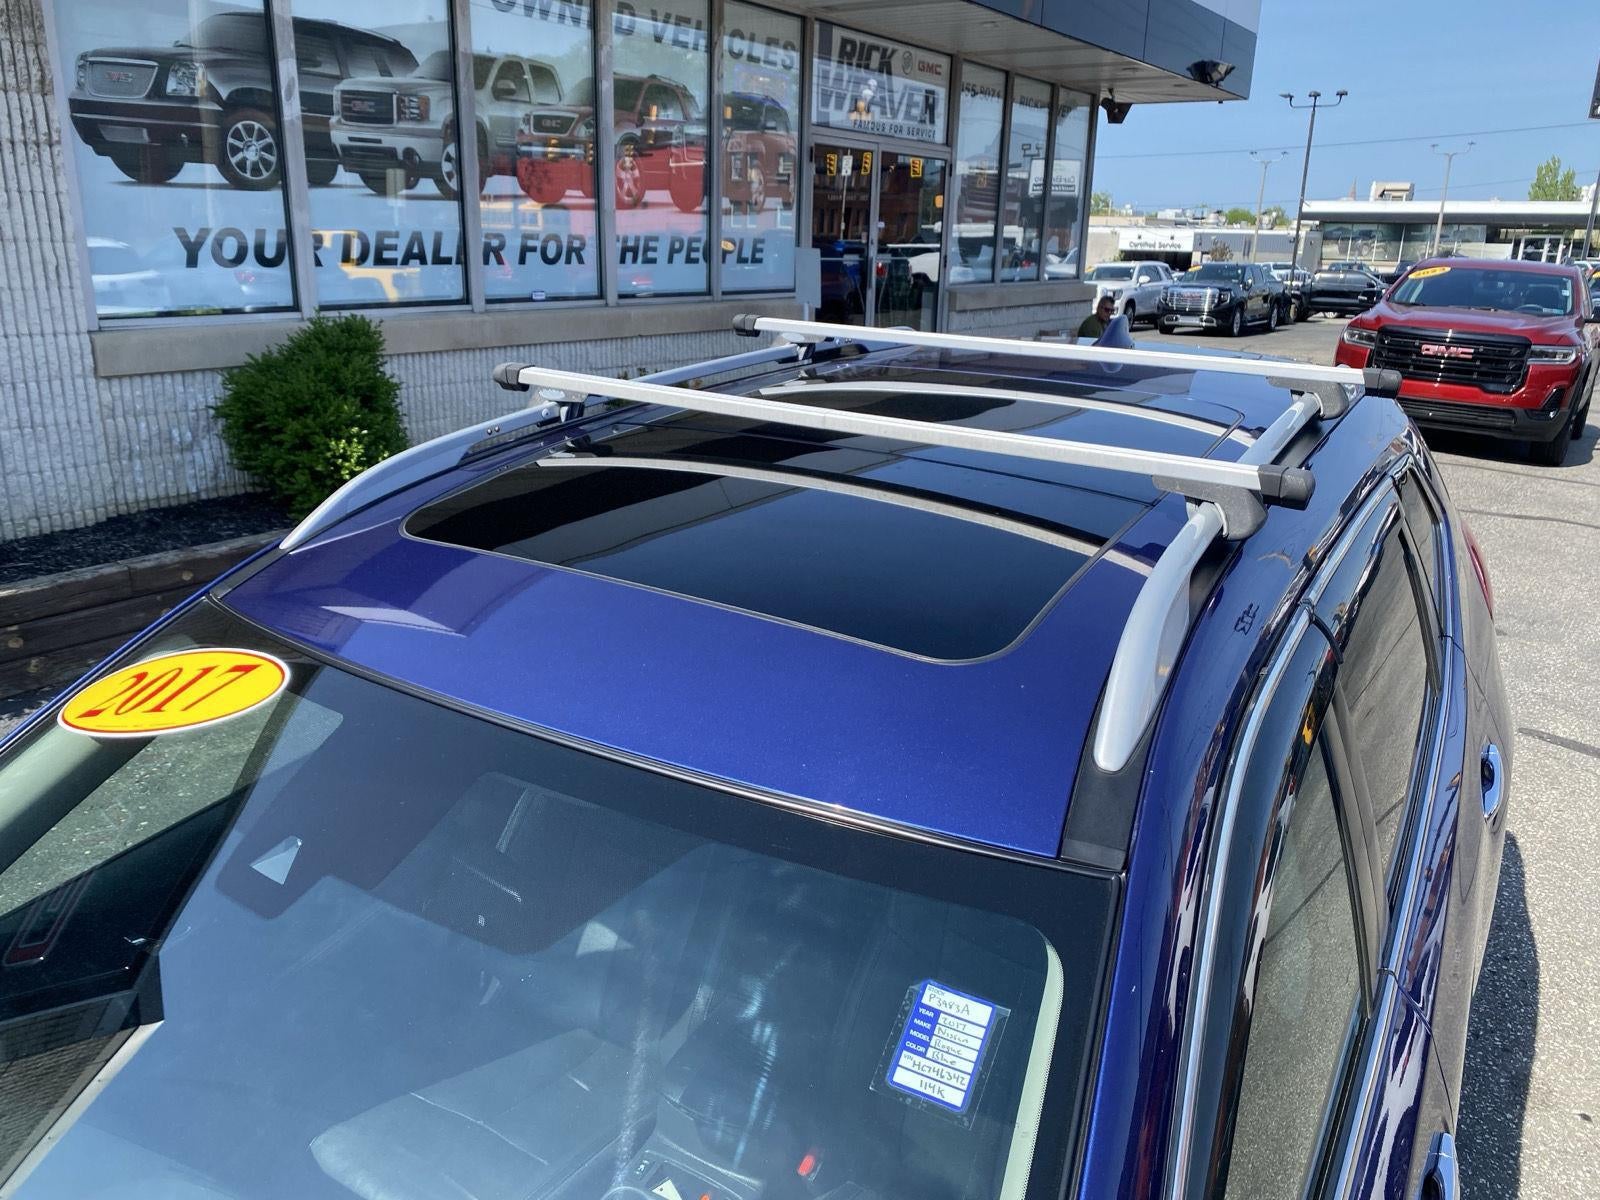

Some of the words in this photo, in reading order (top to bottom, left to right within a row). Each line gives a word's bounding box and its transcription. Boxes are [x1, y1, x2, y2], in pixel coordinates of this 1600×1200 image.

[491, 0, 636, 36] WND
[650, 8, 796, 70] VEHCLES
[837, 36, 898, 76] RICK
[917, 60, 942, 76] GMC
[853, 119, 887, 132] FAMOUS
[889, 123, 903, 135] FOR
[906, 125, 936, 139] SERVICE
[341, 229, 507, 267] DEALR
[518, 233, 587, 265] FOR
[615, 234, 660, 265] HE
[1128, 240, 1157, 249] Certified
[1158, 240, 1182, 249] Service
[1421, 344, 1475, 360] GMC
[75, 664, 263, 719] 2017
[918, 1007, 934, 1018] YEAR
[914, 1018, 932, 1030] MAKE
[909, 1029, 930, 1042] MODEL
[905, 1041, 926, 1053] COLOR
[919, 1079, 945, 1099] 114K
